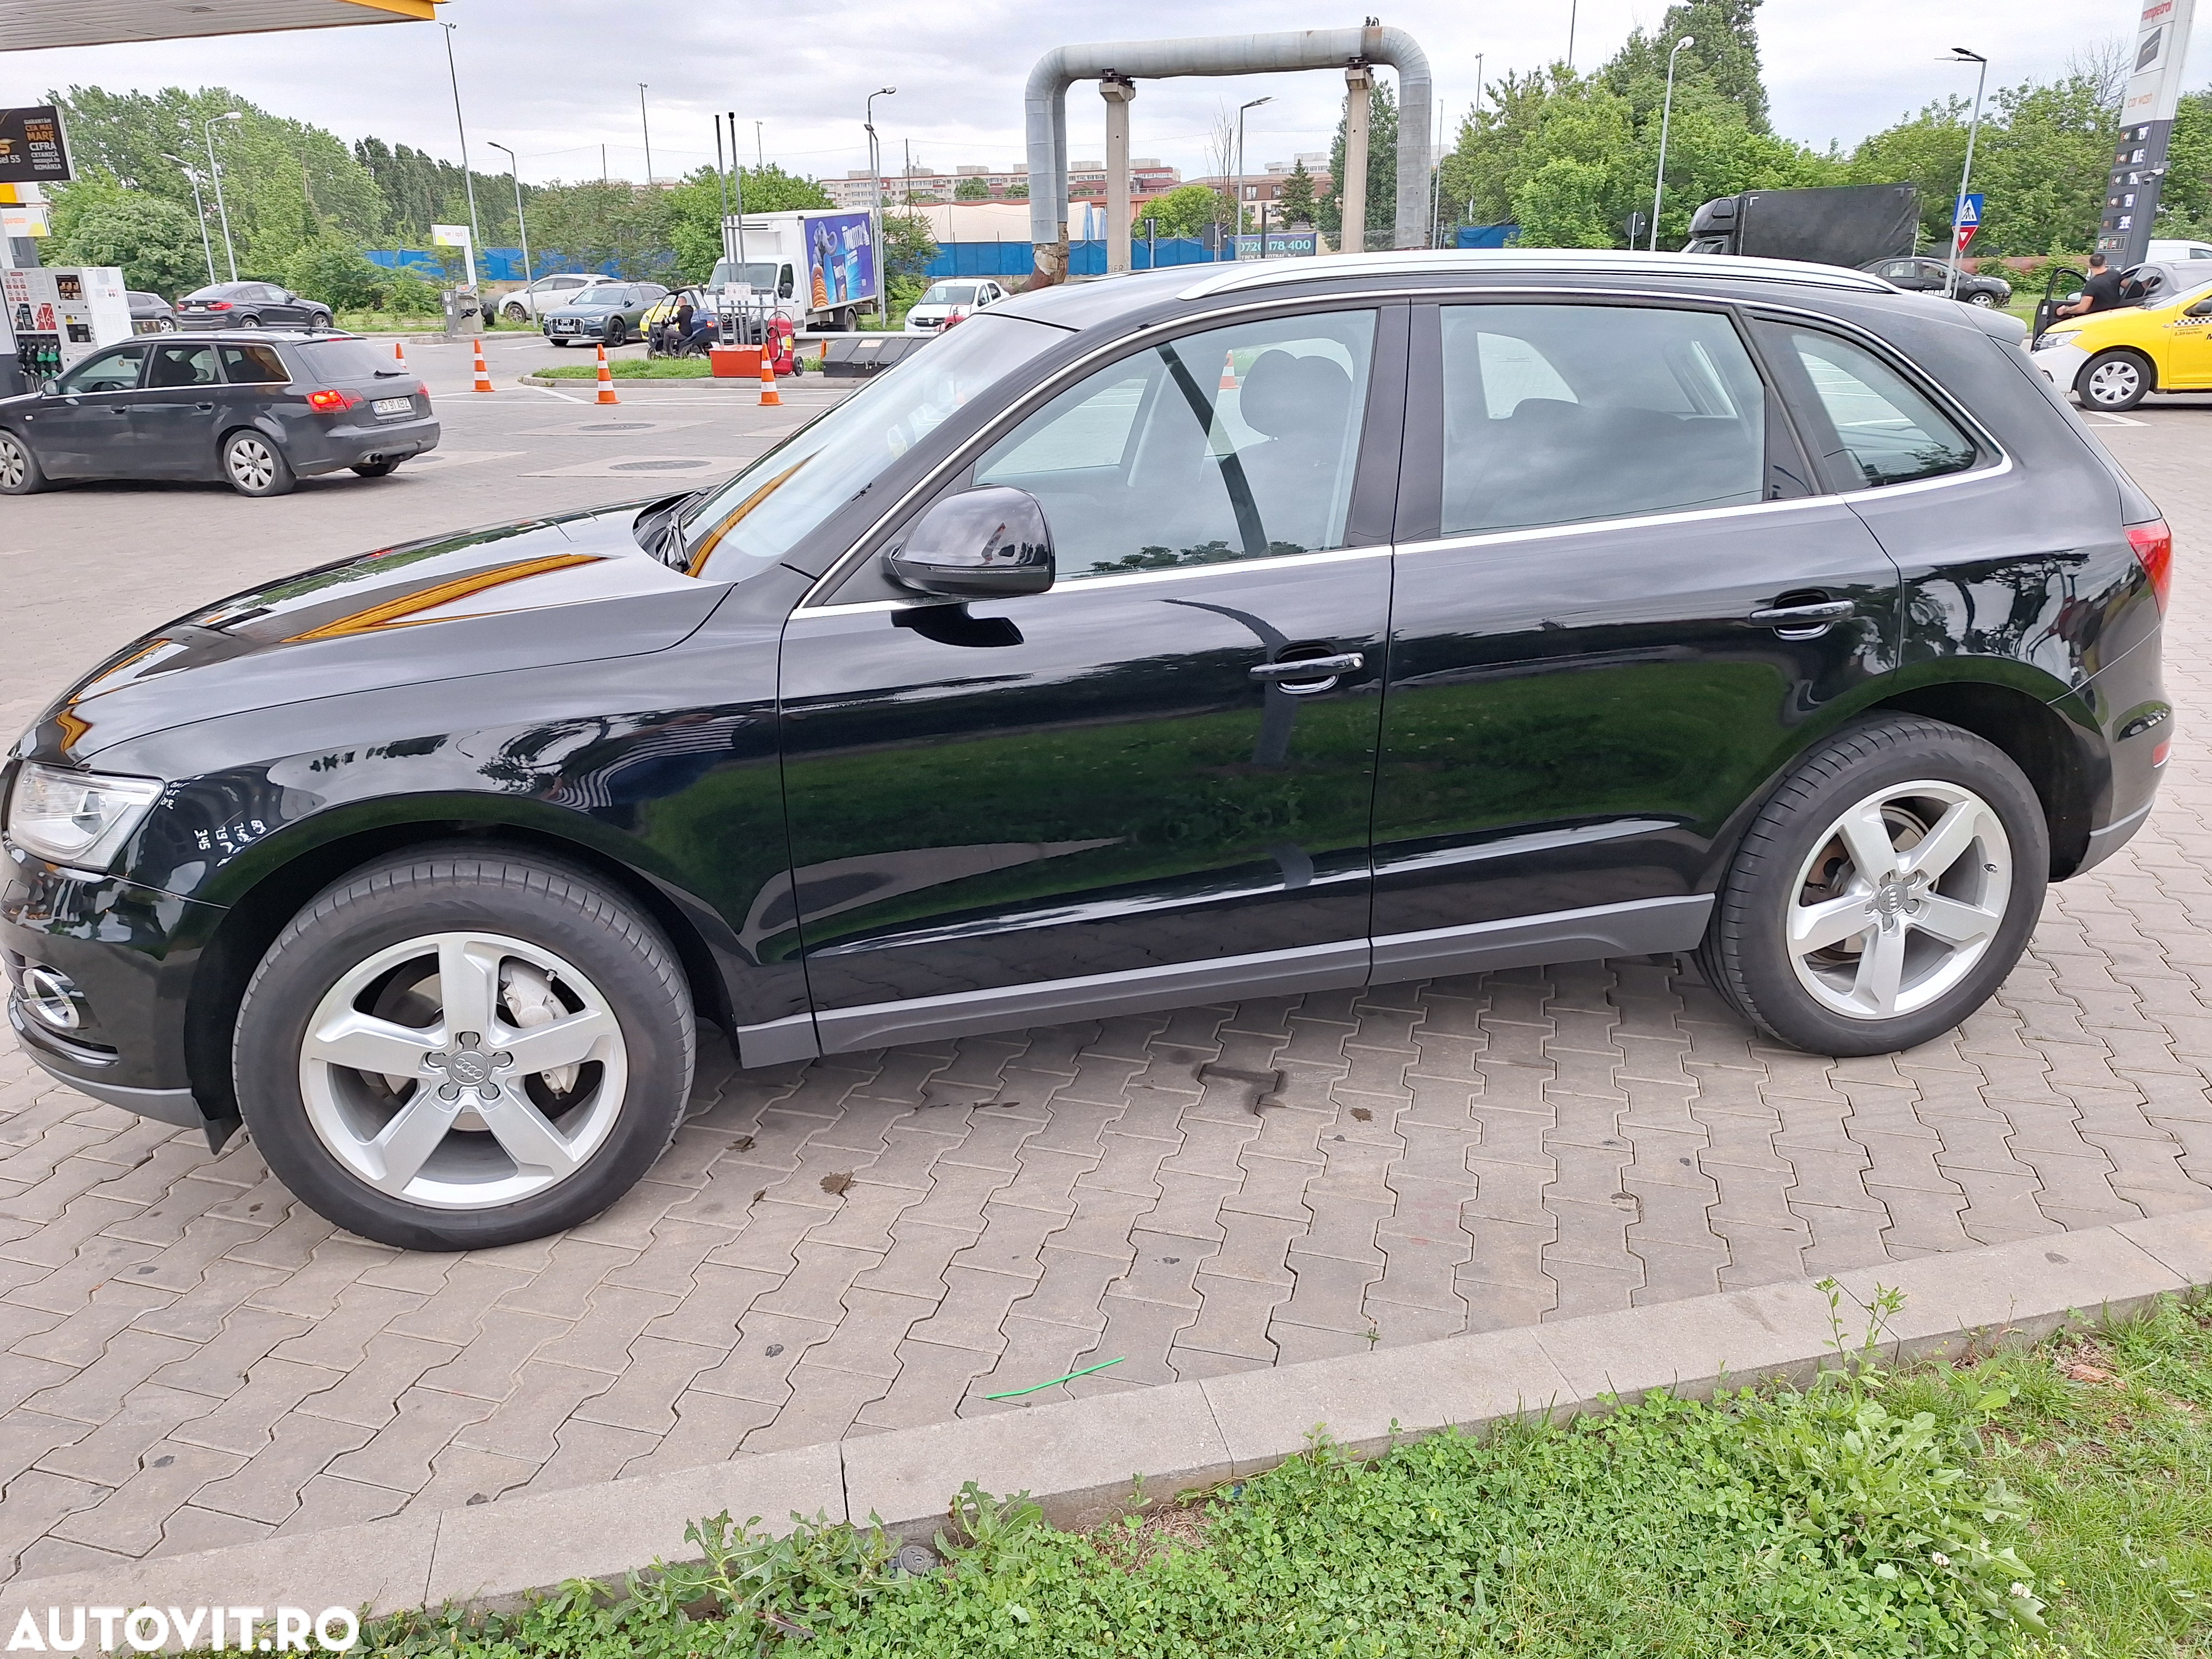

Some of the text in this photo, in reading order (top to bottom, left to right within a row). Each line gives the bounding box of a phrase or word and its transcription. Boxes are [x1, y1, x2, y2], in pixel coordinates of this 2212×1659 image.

[27, 131, 55, 141] MARE
[10, 155, 21, 163] 55
[1269, 241, 1285, 250] 178
[1288, 240, 1311, 250] 400
[376, 398, 410, 411] HD 91 ABZ
